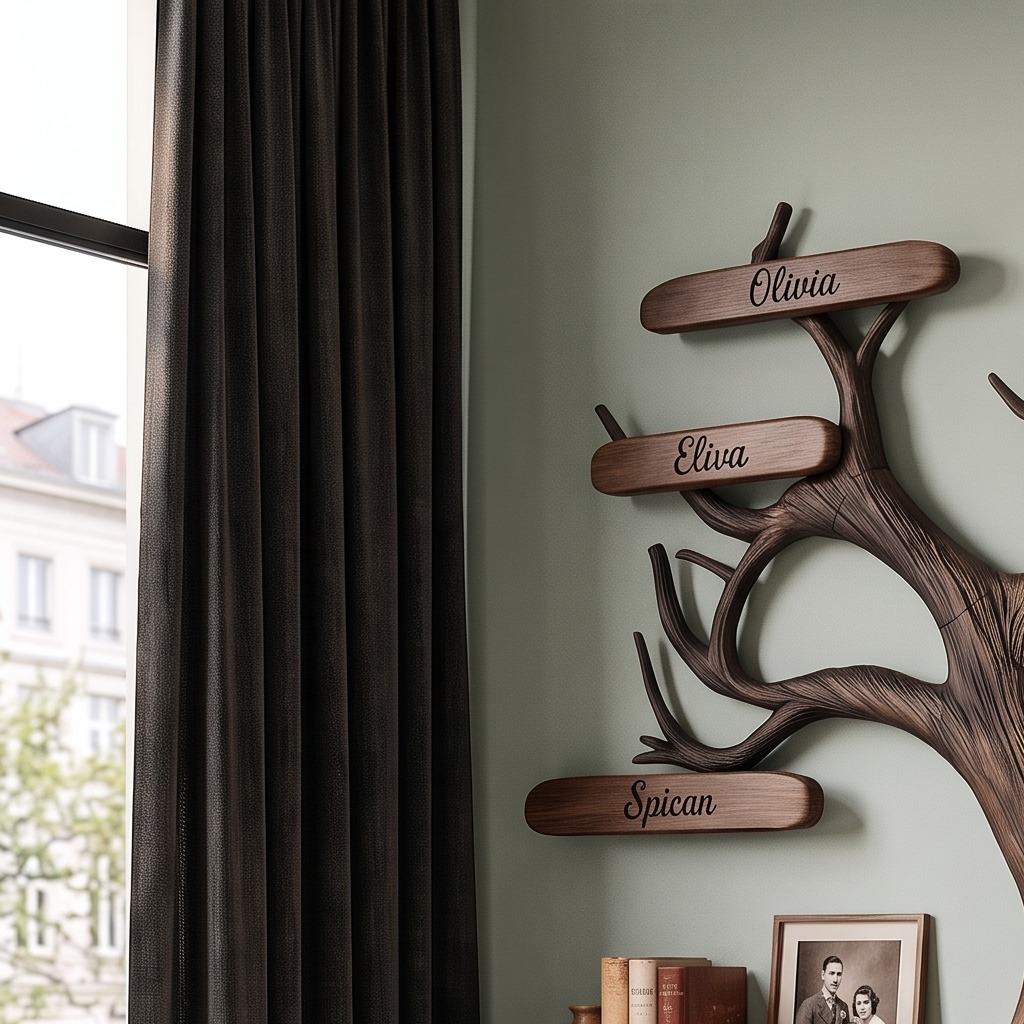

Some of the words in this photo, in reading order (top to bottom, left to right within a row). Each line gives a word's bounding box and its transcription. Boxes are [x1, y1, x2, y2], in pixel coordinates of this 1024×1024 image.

[749, 265, 841, 307] Olivia
[674, 435, 749, 475] Eliva
[623, 779, 717, 828] Spican
